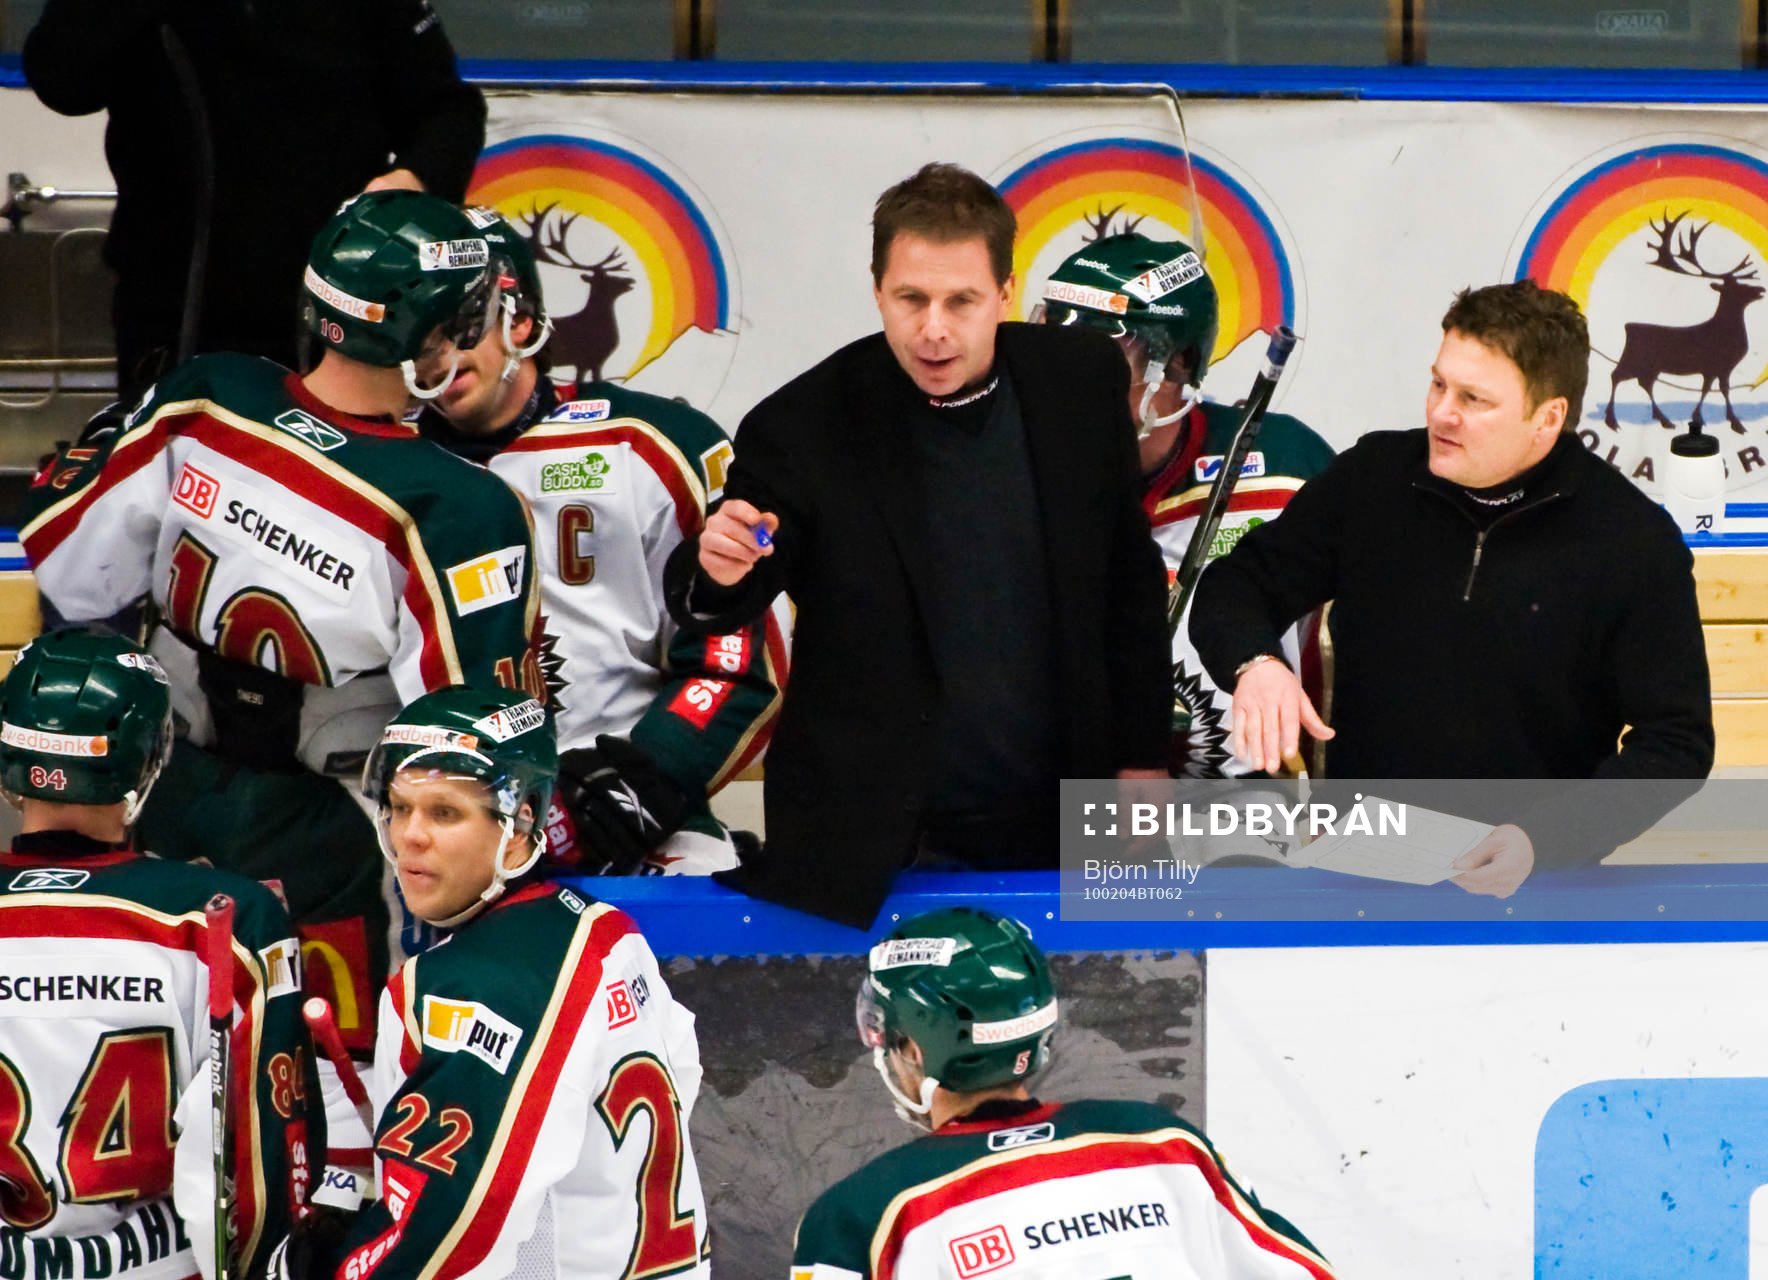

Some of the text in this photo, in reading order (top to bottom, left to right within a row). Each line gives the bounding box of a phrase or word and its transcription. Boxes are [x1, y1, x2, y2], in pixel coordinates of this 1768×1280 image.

[1074, 258, 1111, 272] Reebok
[1149, 304, 1184, 316] Reebok
[320, 317, 345, 344] 10
[569, 402, 605, 411] INTER
[569, 410, 604, 420] SPORT
[543, 463, 580, 477] CASH
[175, 467, 356, 591] DB SCHENKER
[1212, 528, 1244, 543] ASH
[557, 504, 595, 586] C
[169, 528, 334, 688] 10
[494, 647, 548, 704] 10
[29, 765, 67, 791] 84
[0, 974, 165, 1003] SCHENKER
[1013, 1049, 1031, 1075] 5
[375, 1092, 474, 1177] 22
[594, 1050, 711, 1280] 2
[325, 1170, 358, 1193] KA
[954, 1202, 1170, 1273] DB SCHENKER
